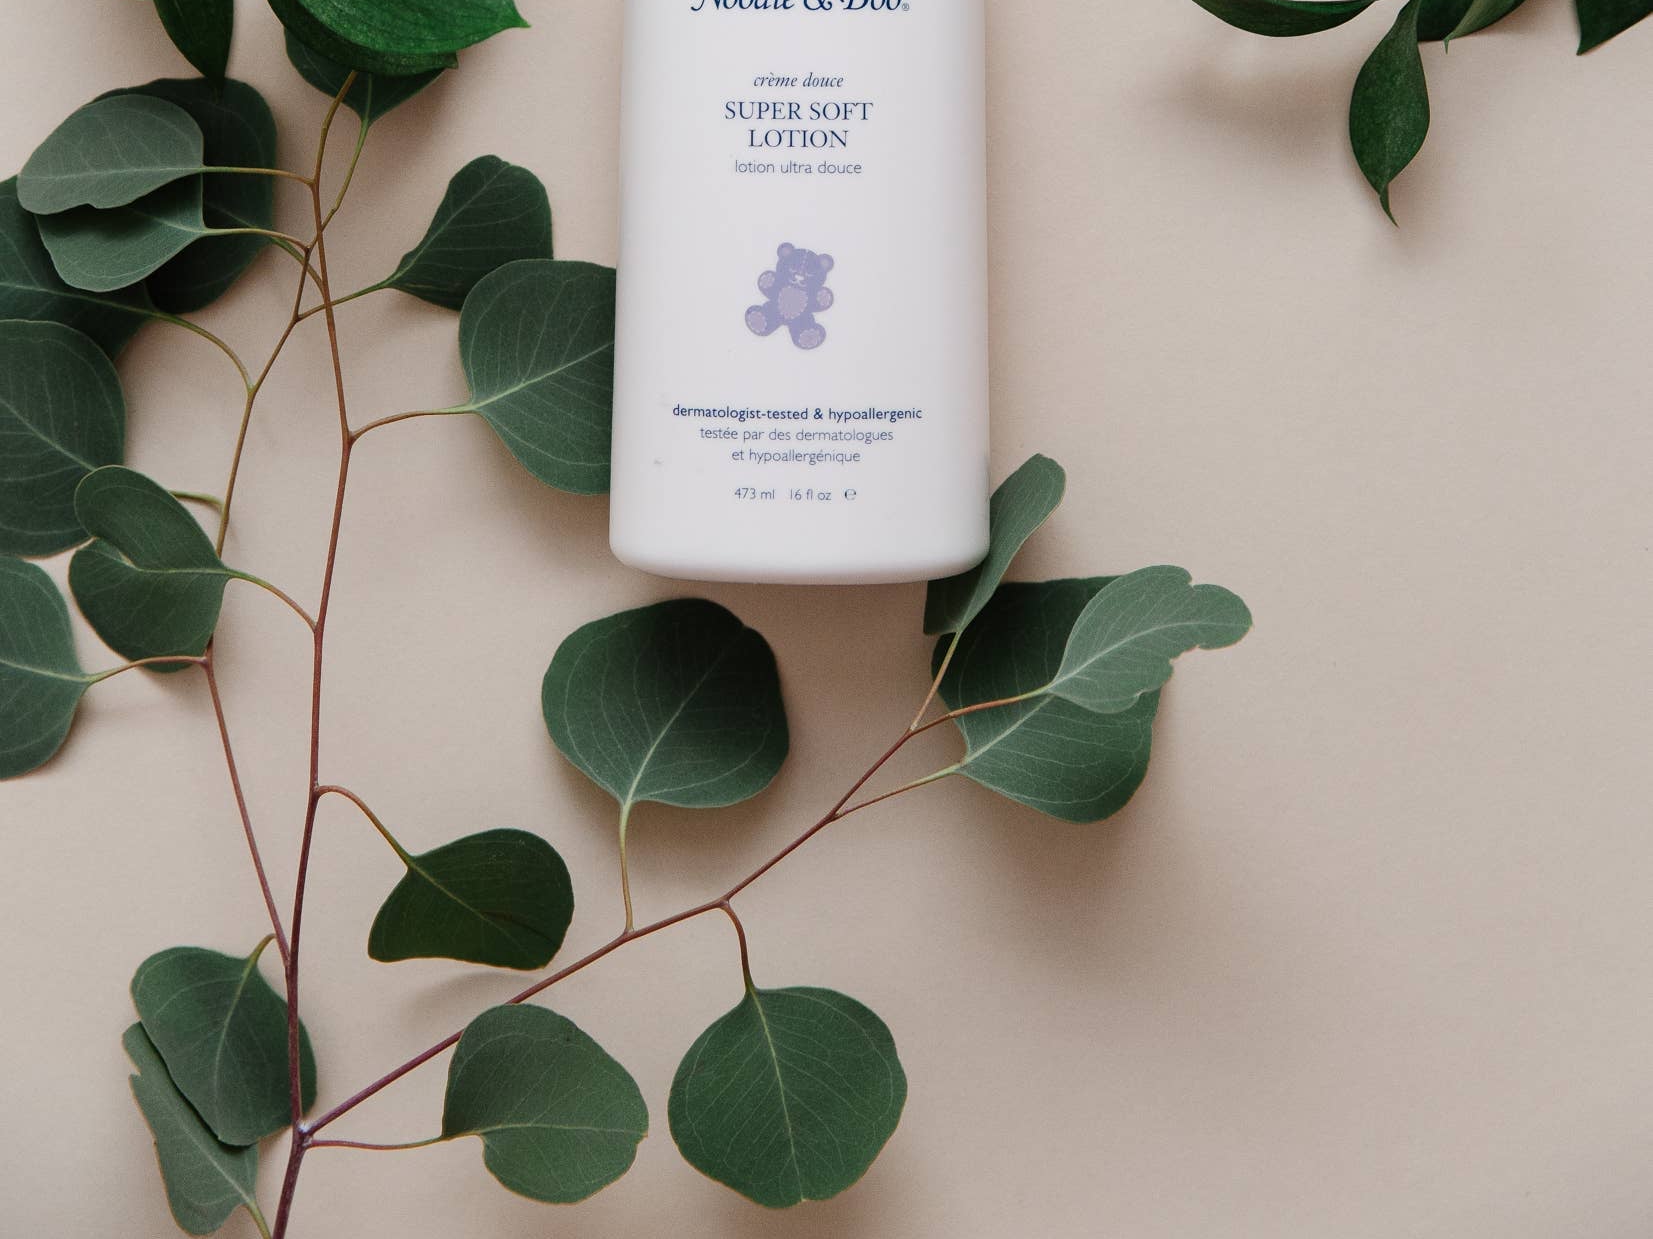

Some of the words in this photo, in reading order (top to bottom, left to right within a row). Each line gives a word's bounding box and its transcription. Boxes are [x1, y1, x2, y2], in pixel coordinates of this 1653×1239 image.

[753, 72, 798, 88] crème
[802, 72, 844, 88] douce
[724, 101, 803, 120] SUPER
[809, 101, 874, 121] SOFT
[748, 129, 849, 148] LOTION
[735, 159, 775, 174] lotion
[780, 160, 813, 175] ultra
[817, 160, 862, 175] douce
[672, 403, 809, 422] dermatologist-tested
[813, 407, 824, 420] &
[828, 407, 923, 424] hypoallergenic
[700, 427, 739, 440] testée
[743, 430, 765, 443] par
[768, 429, 791, 441] des
[795, 429, 894, 445] dermatologues
[731, 450, 745, 461] et
[749, 448, 861, 466] hypoallergénique
[734, 488, 757, 501] 473
[760, 488, 775, 500] ml
[789, 489, 802, 501] 16
[805, 488, 814, 500] fl
[817, 491, 832, 501] oz
